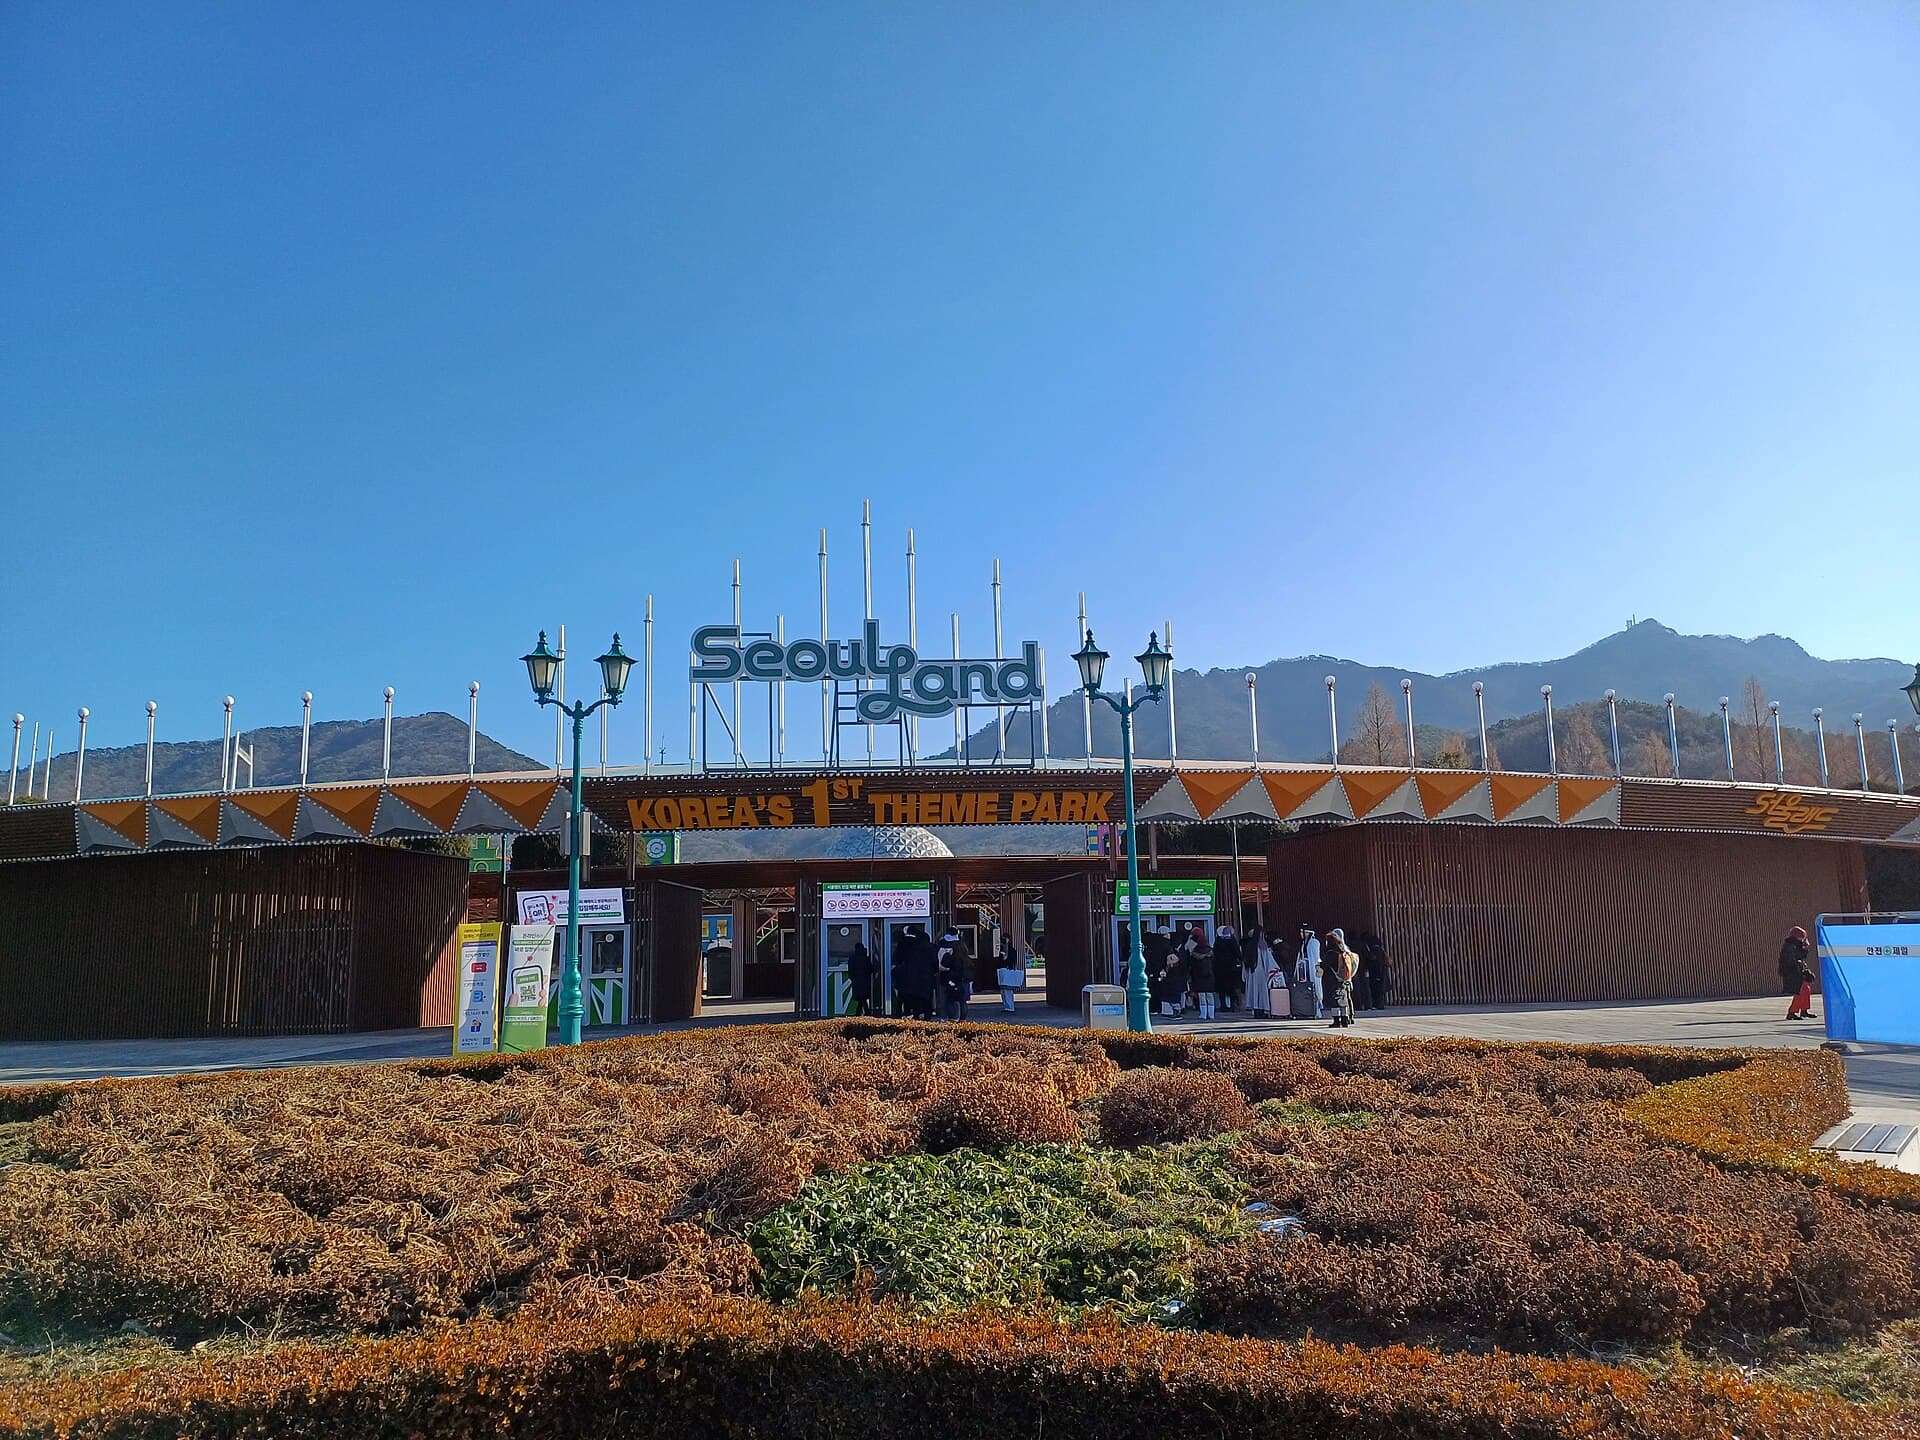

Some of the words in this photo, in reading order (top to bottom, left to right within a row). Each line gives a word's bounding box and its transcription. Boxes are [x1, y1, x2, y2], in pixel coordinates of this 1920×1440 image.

[690, 619, 884, 682] Seoul
[856, 645, 1046, 724] Land
[627, 794, 794, 830] KOREA'S
[868, 791, 999, 824] THEME
[1011, 791, 1114, 823] PARK
[533, 909, 543, 917] QR
[1866, 946, 1882, 956] 안전
[1892, 946, 1908, 956] 제일
